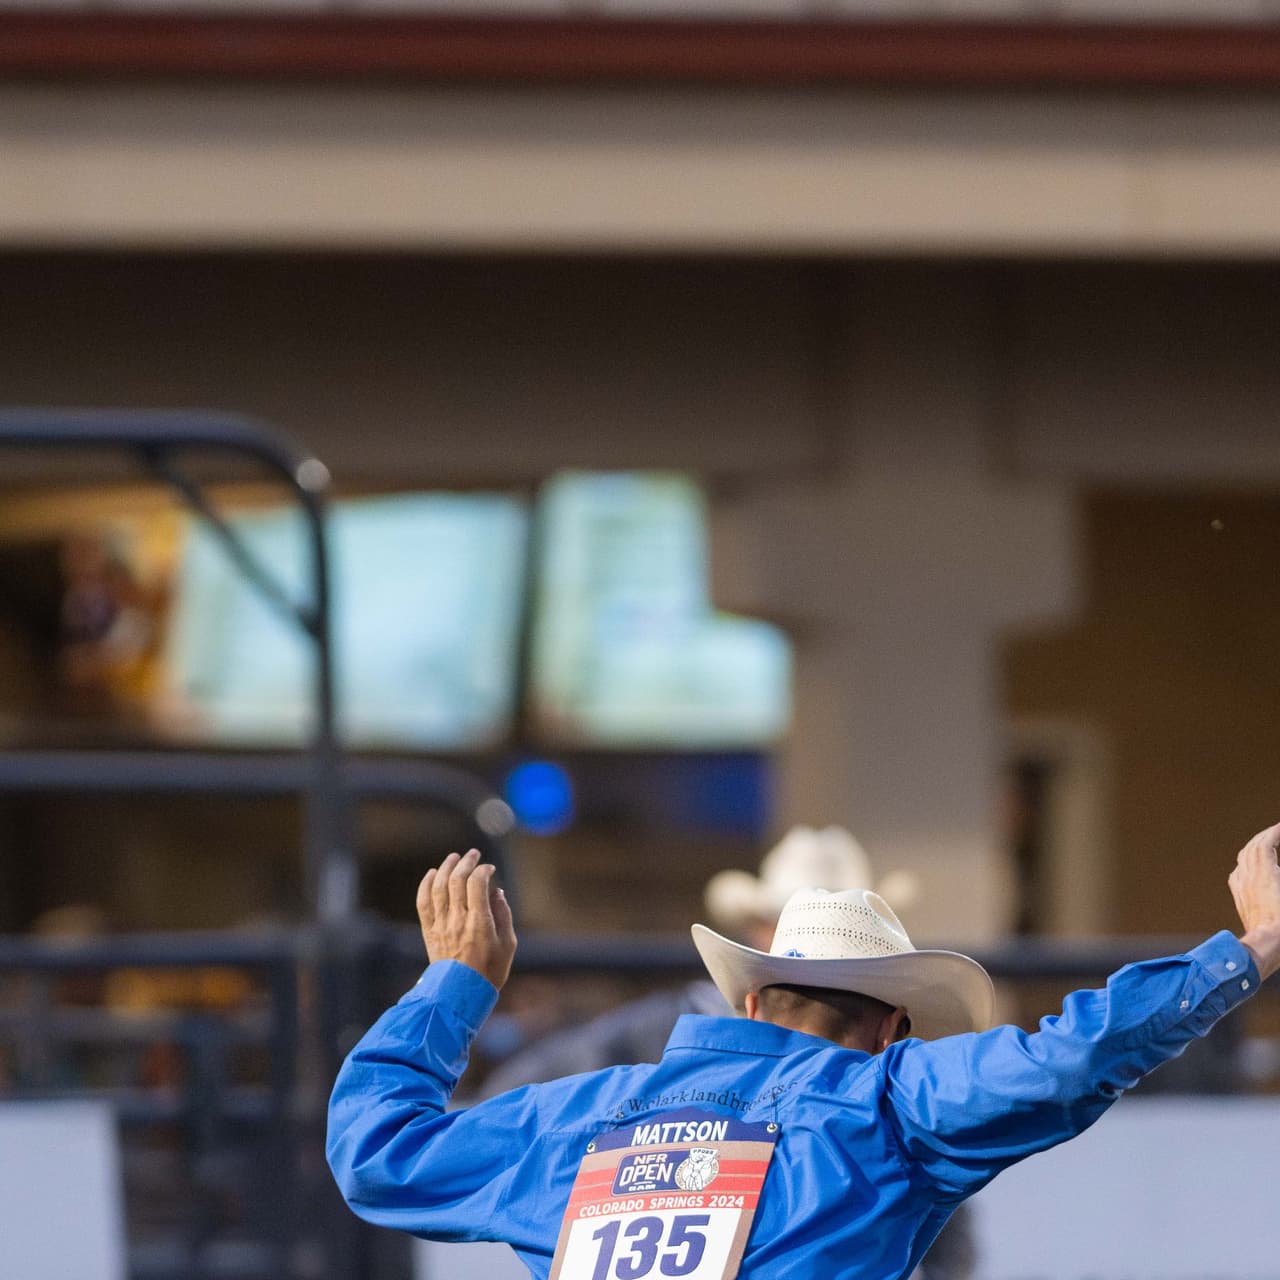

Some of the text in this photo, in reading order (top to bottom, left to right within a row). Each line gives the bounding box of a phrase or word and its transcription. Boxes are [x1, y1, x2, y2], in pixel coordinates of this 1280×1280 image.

[631, 1120, 728, 1146] MATTSON
[633, 1153, 668, 1165] NFR
[619, 1162, 674, 1187] OPEN
[579, 1195, 744, 1218] COLORADO SPRINGS 2024
